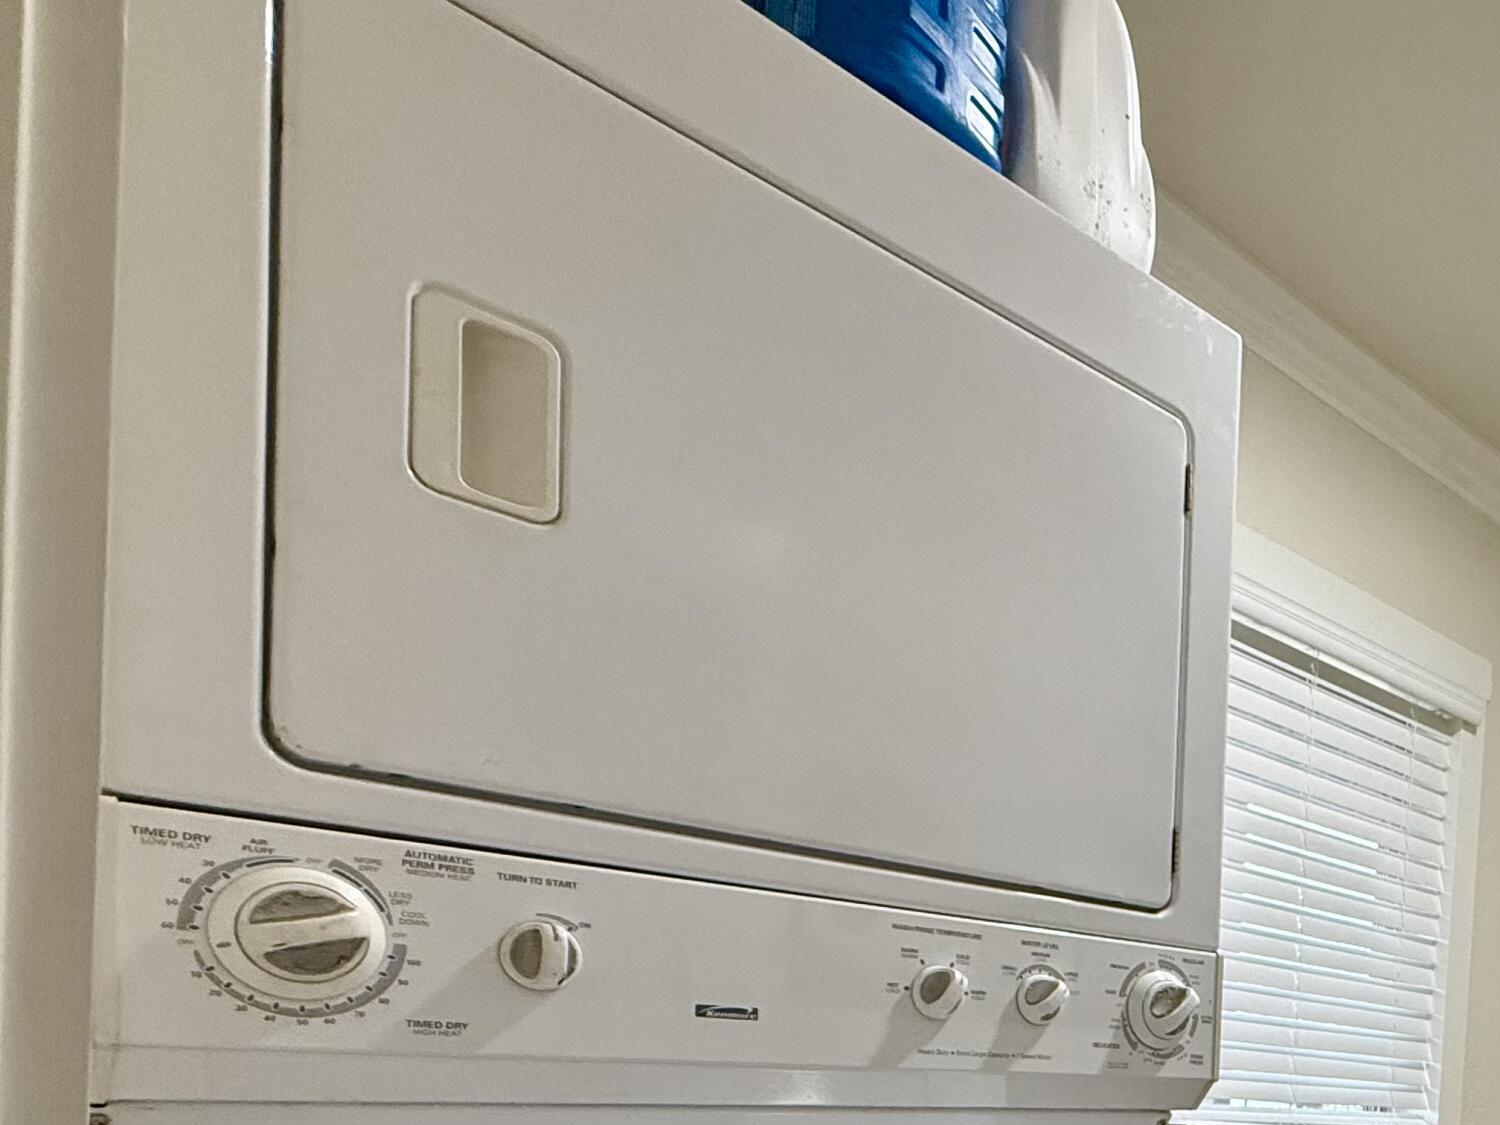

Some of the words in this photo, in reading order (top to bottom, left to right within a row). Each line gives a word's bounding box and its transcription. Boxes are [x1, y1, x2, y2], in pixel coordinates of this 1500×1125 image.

[131, 825, 178, 839] TIMED
[182, 832, 212, 843] DRY
[404, 849, 475, 866] AUTOMATIC
[401, 859, 436, 871] PERM
[438, 864, 475, 876] PRESS
[496, 872, 528, 884] TURN
[529, 877, 544, 886] TO
[545, 878, 579, 890] START
[406, 1018, 443, 1030] TIMED
[445, 1021, 469, 1031] DRY
